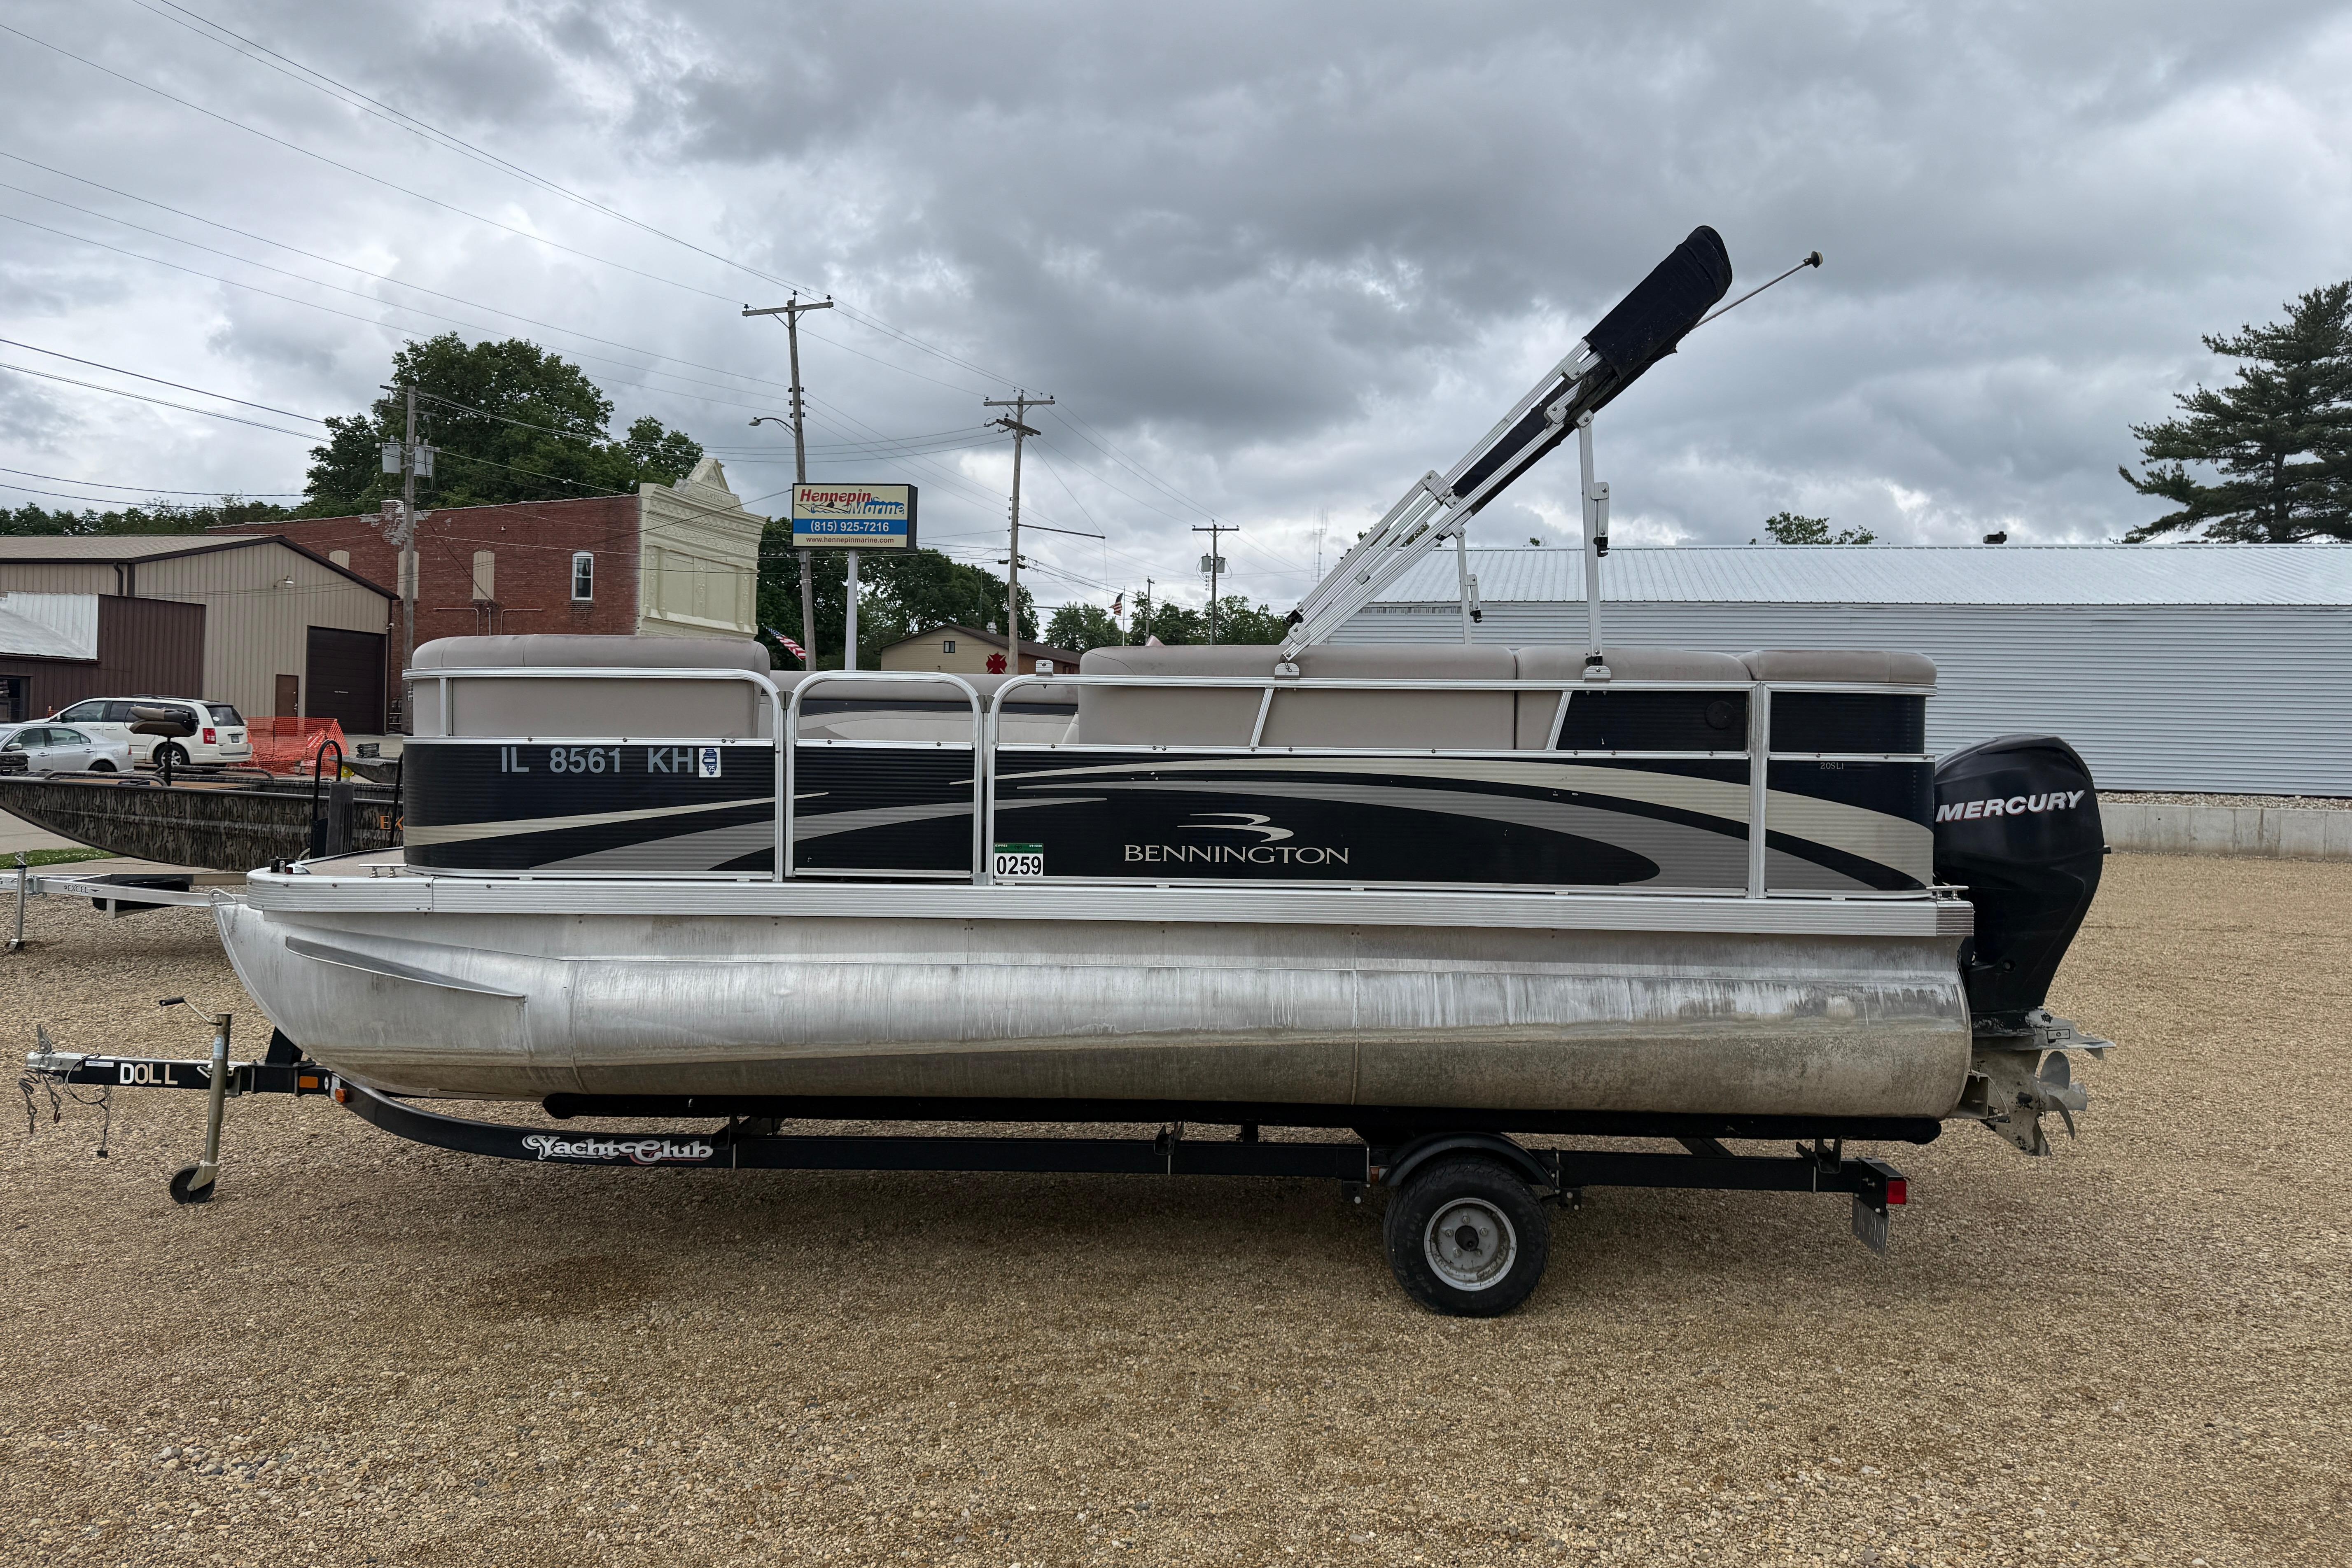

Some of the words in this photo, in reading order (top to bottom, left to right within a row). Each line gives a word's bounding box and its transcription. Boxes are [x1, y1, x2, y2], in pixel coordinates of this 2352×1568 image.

[800, 489, 872, 506] Hennepin
[849, 502, 905, 514] Marine
[811, 520, 837, 532] (815)
[840, 521, 889, 532] 925-7216
[501, 747, 529, 772] IL
[549, 747, 621, 773] 8561
[647, 747, 694, 773] KH
[1935, 790, 2085, 823] MERCURY
[1125, 845, 1349, 864] BENNINGTON
[996, 856, 1041, 875] 0259
[68, 884, 89, 893] EXCEL
[120, 1063, 178, 1085] DOLL
